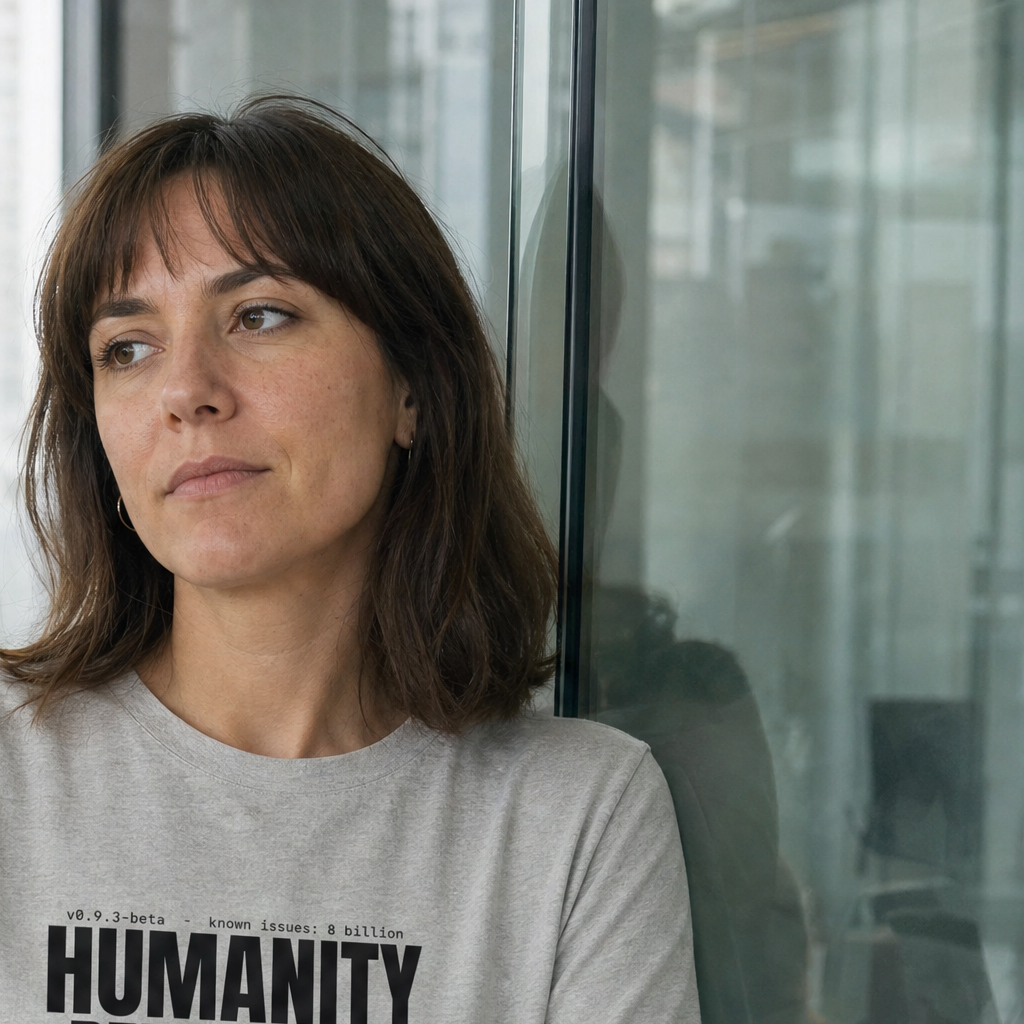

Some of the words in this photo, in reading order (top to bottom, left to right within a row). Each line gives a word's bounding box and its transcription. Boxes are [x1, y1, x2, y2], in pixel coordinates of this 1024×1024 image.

[66, 909, 165, 926] v0.9.3-beta
[209, 916, 251, 931] known
[261, 919, 317, 935] issues:
[327, 924, 336, 936] 8
[344, 925, 404, 940] billion
